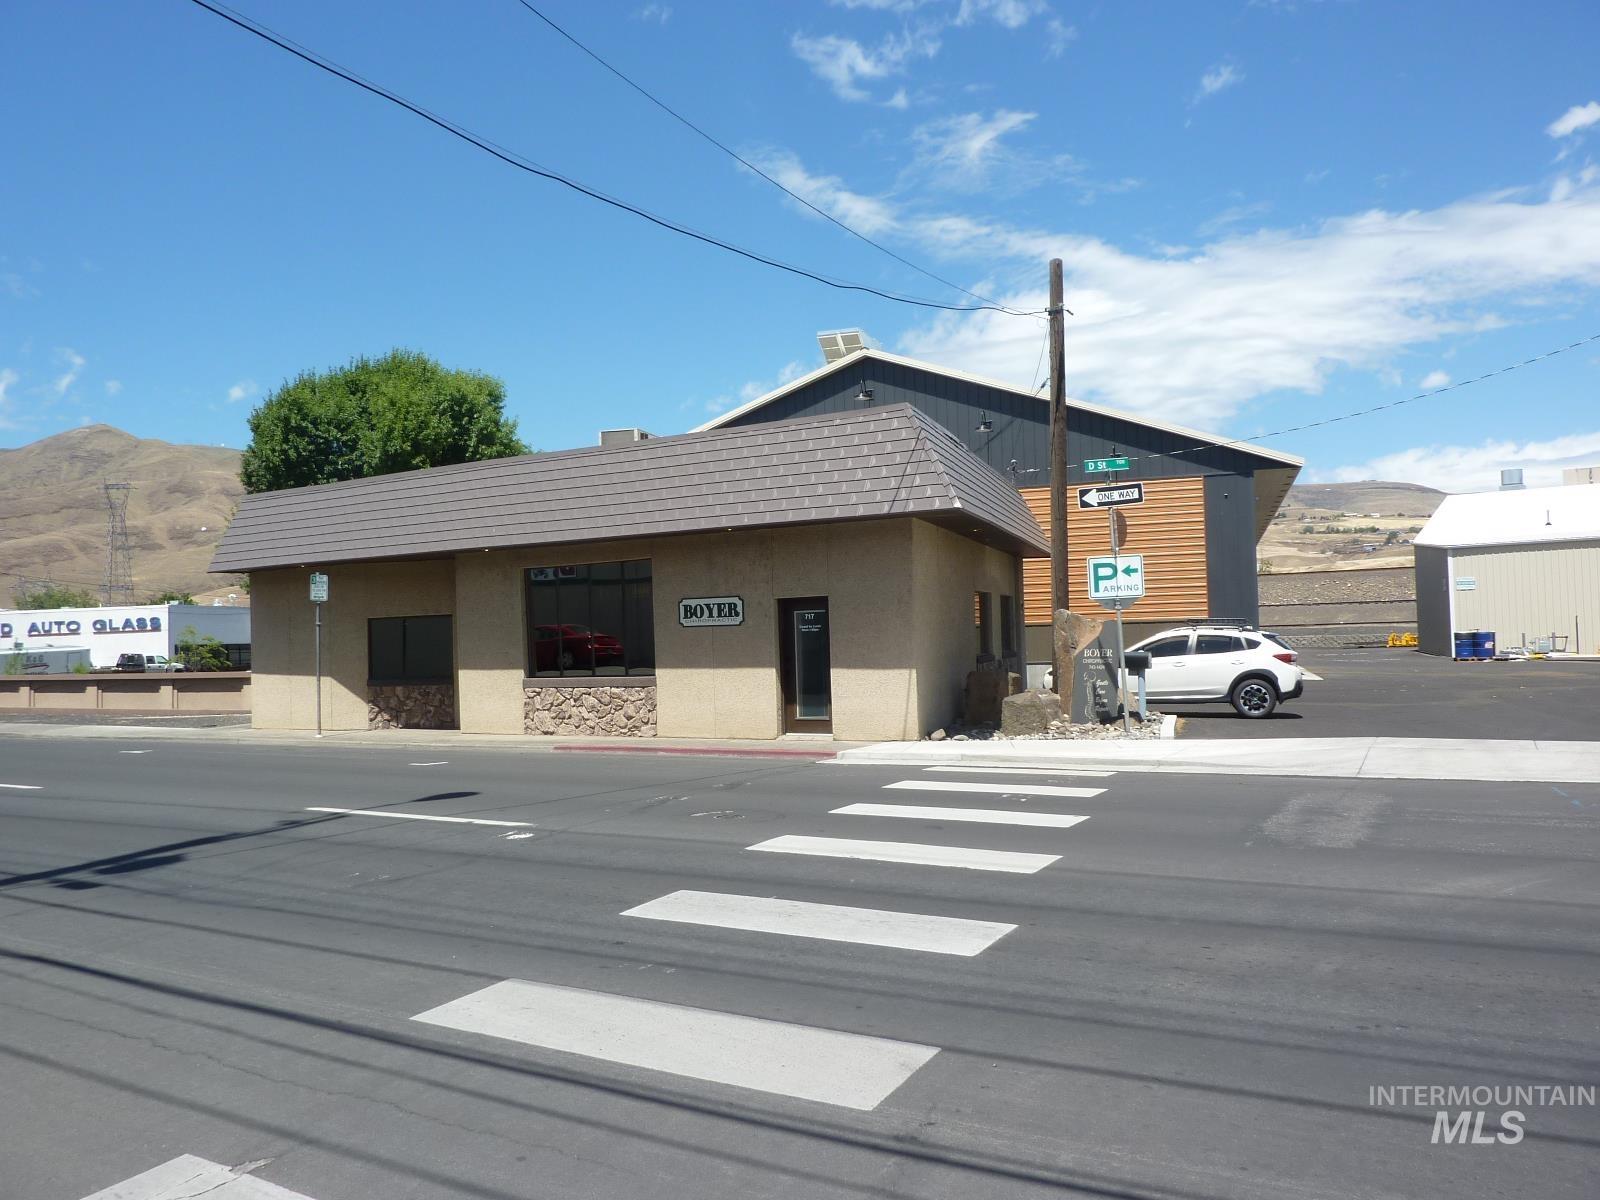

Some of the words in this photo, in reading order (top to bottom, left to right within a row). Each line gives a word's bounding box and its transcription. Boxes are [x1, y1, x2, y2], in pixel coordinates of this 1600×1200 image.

[1088, 462, 1095, 470] D
[1097, 461, 1107, 469] St
[1097, 491, 1116, 501] ONE
[1118, 489, 1136, 499] WAY
[682, 602, 740, 619] BOYER
[27, 620, 81, 635] AUTO
[92, 616, 162, 633] GLASS
[1084, 648, 1113, 657] BOYER
